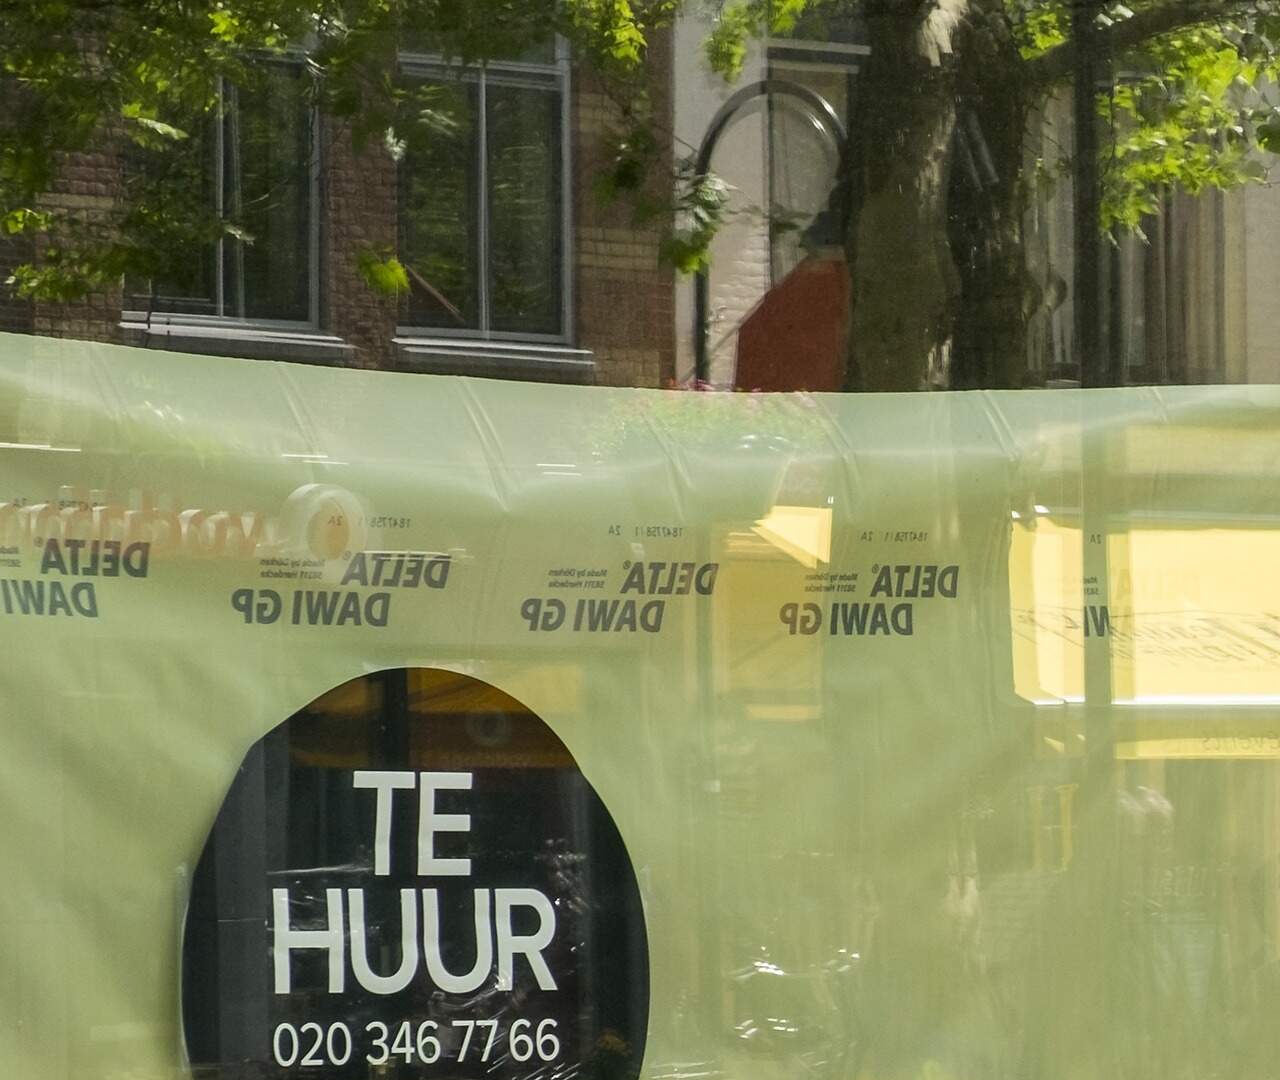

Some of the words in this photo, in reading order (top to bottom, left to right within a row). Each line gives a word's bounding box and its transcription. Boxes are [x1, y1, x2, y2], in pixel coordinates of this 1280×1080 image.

[352, 770, 474, 876] TE
[272, 887, 558, 995] HUUR
[273, 1021, 353, 1067] 020
[365, 1020, 442, 1066] 346
[451, 1019, 499, 1064] 77
[509, 1018, 560, 1063] 66
